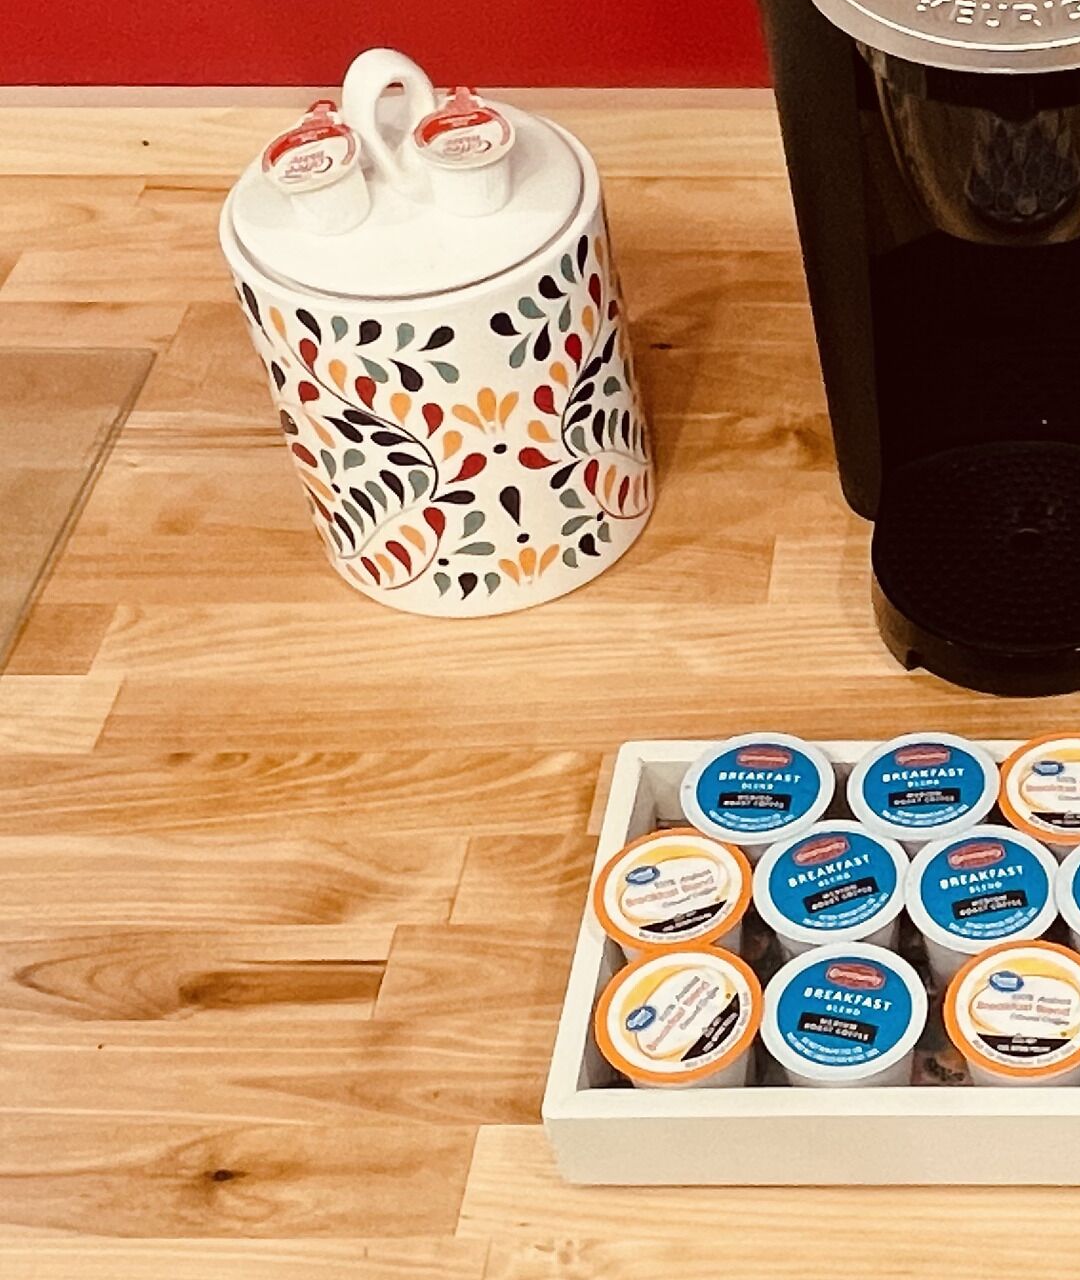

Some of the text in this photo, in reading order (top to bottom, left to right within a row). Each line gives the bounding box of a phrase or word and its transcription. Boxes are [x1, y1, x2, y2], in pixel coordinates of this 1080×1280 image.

[719, 770, 801, 784] BREAKFAST
[882, 768, 965, 782] BREAKFAST
[787, 854, 871, 888] BREAKFAST
[939, 865, 1024, 890] BREAKFAST
[803, 986, 892, 1013] BREAKFAST
